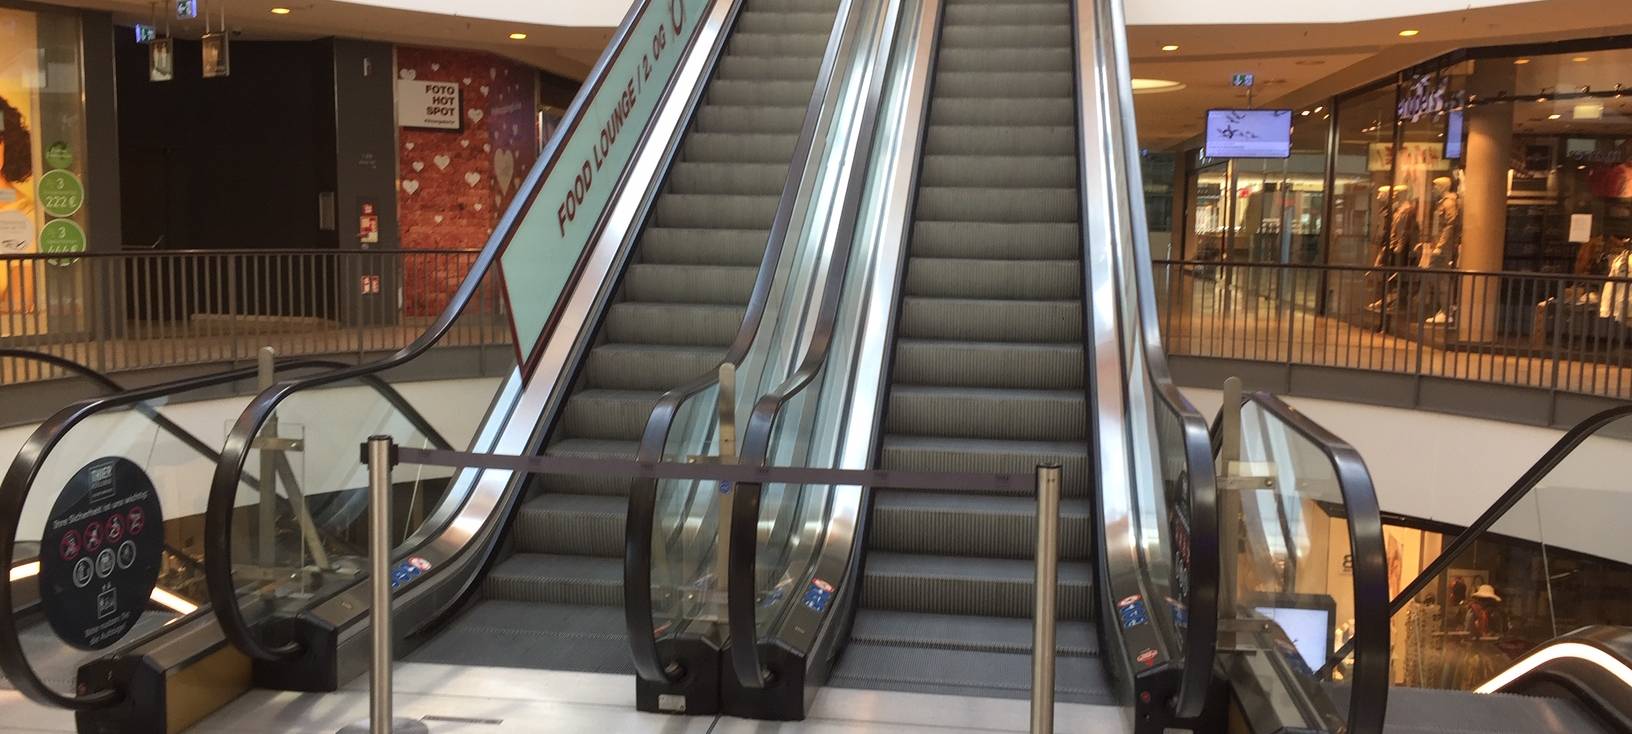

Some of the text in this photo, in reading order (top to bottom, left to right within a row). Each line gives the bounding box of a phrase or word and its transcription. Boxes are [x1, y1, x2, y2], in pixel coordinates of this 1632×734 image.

[425, 85, 455, 95] FOTO
[432, 96, 455, 106] HOT
[426, 106, 455, 116] SPOT
[558, 160, 593, 238] FOOD
[593, 78, 637, 171] LOUNGE
[652, 24, 666, 61] OG
[56, 178, 65, 189] 3
[58, 226, 66, 238] 3
